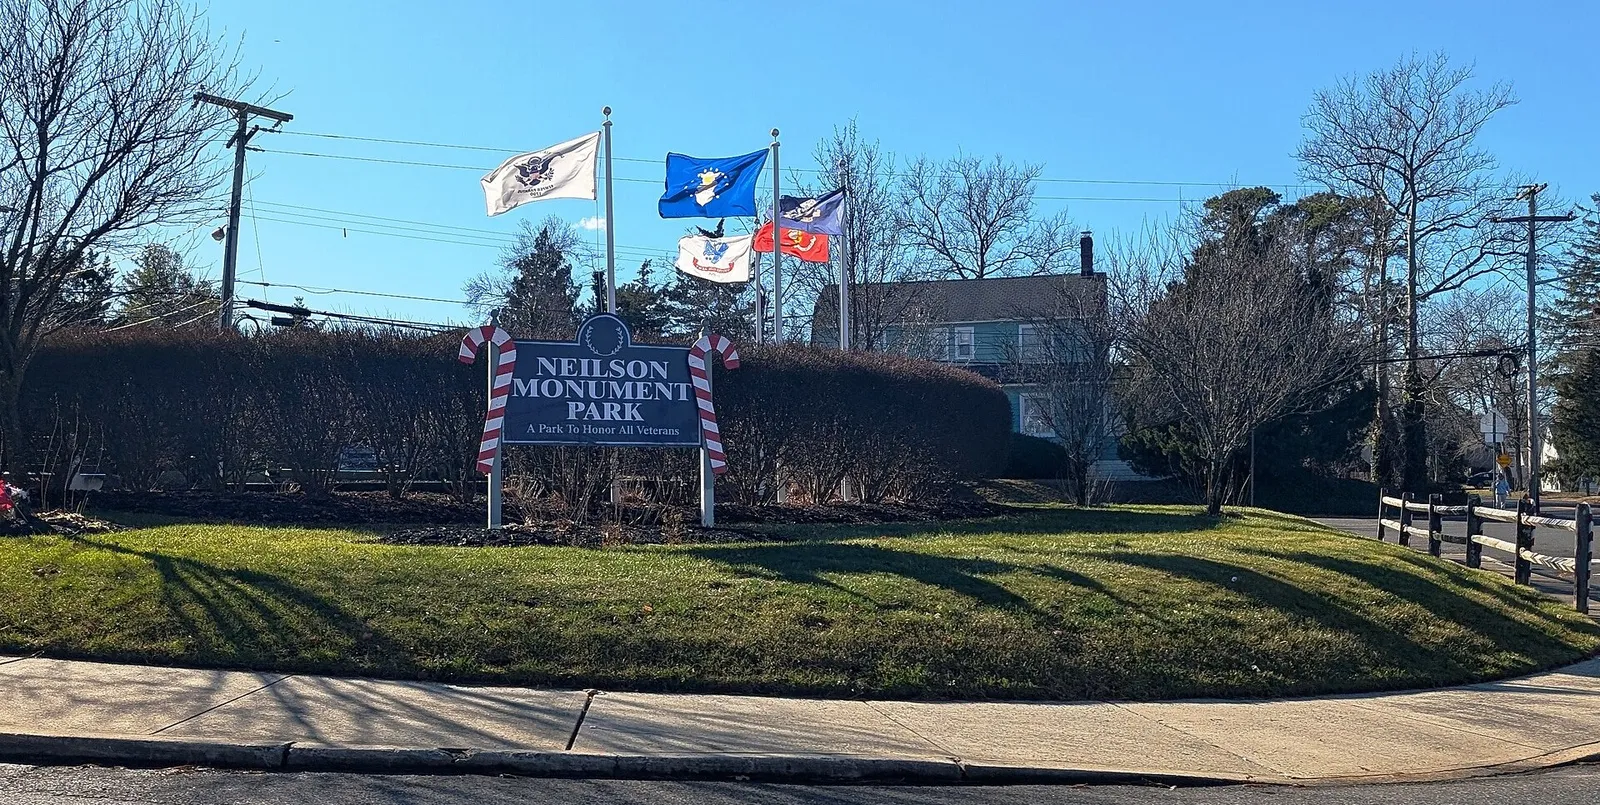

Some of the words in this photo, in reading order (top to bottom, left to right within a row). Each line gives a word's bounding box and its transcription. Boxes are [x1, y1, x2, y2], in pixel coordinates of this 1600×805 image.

[536, 357, 669, 379] NEILSON
[512, 378, 692, 401] MONUMENT
[566, 402, 645, 421] PARK
[527, 424, 535, 434] A
[539, 424, 563, 434] Park
[566, 424, 580, 434] To
[583, 425, 616, 435] Honor
[619, 425, 634, 435] All
[637, 426, 680, 436] Veterans
